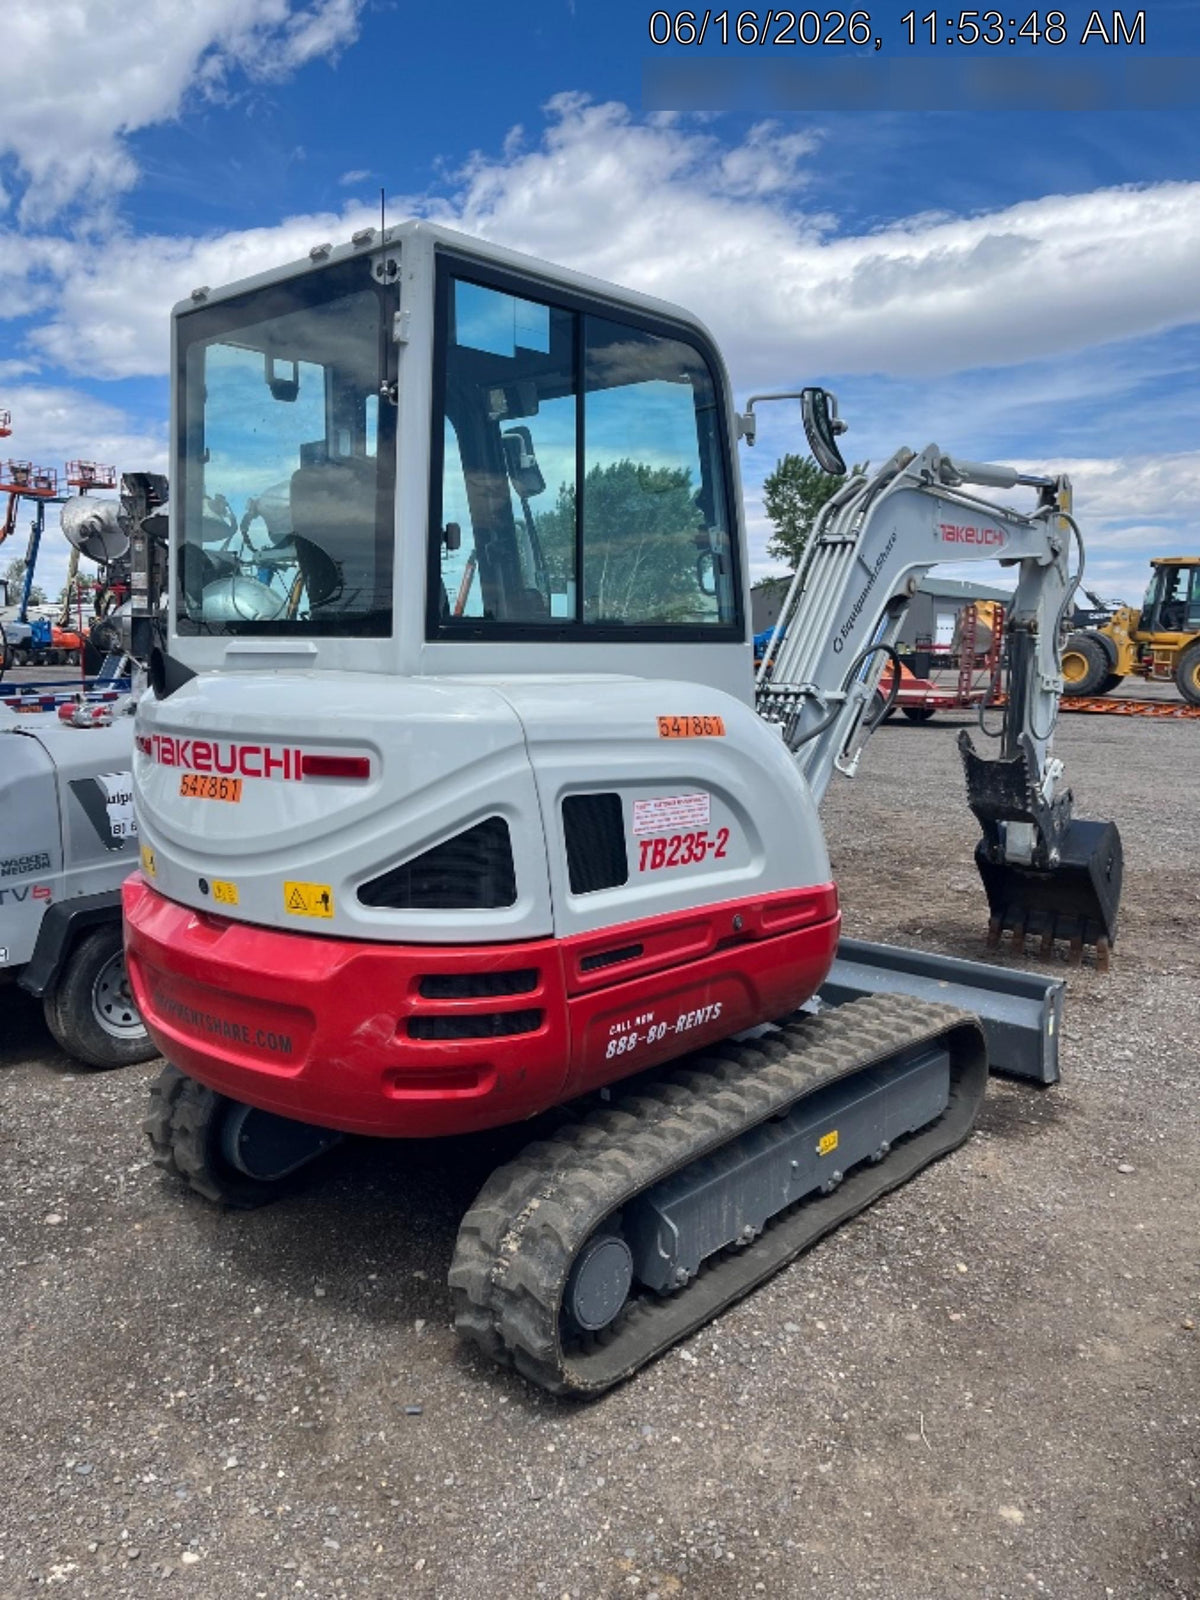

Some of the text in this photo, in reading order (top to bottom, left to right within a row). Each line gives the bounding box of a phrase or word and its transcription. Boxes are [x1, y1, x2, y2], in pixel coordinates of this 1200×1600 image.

[658, 716, 723, 737] 547861
[180, 774, 238, 801] 547861
[638, 827, 730, 872] TB235-2
[606, 1002, 723, 1059] 888-80-RENTS
[609, 1020, 632, 1035] CALL
